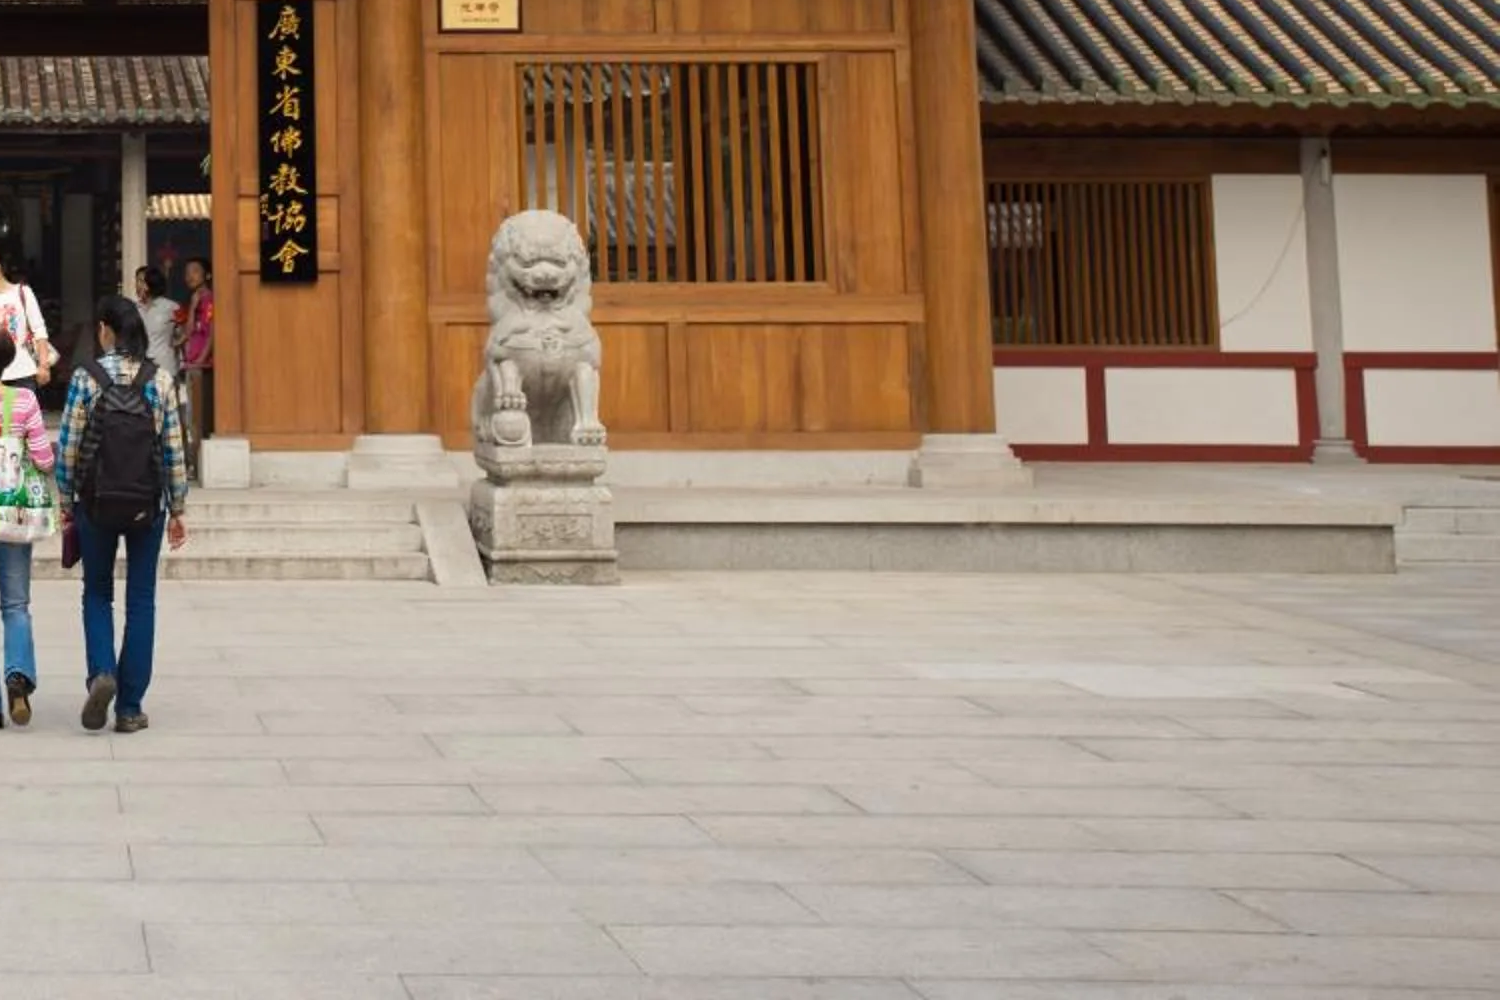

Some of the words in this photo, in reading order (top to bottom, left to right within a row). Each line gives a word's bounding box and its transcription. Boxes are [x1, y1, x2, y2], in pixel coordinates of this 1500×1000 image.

[268, 5, 309, 274] 廣東省佛教協會
